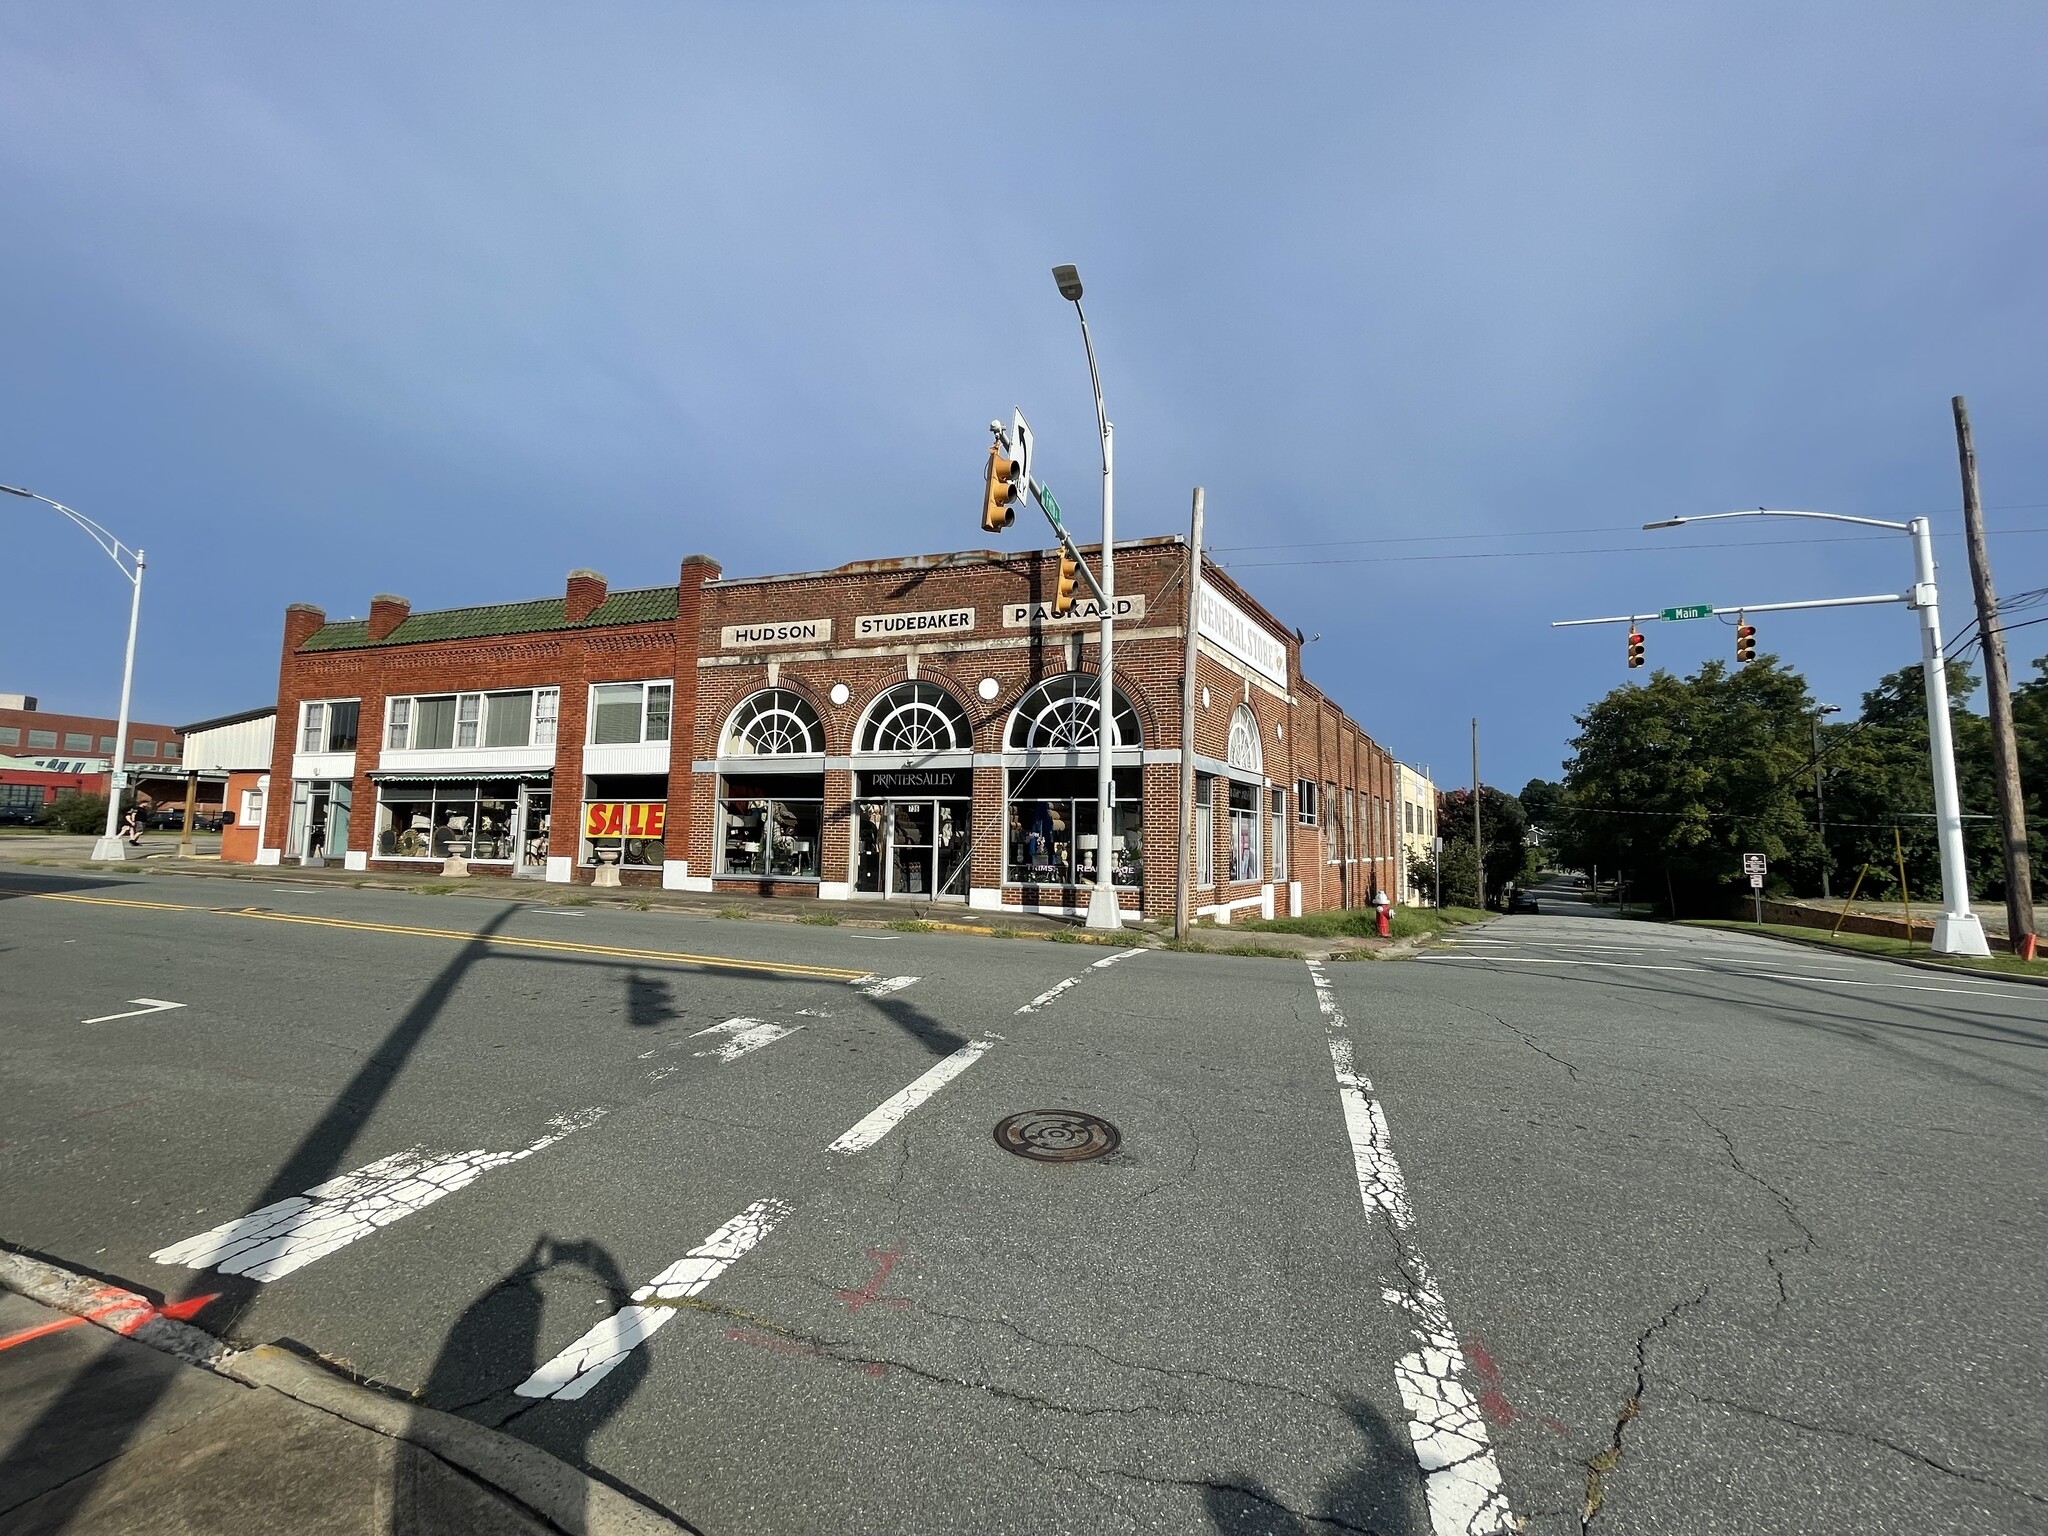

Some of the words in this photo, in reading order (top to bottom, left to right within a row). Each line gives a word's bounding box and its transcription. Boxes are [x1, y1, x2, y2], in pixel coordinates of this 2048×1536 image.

[861, 612, 970, 633] STUDEBAKER
[1675, 607, 1698, 619] Main
[735, 624, 817, 643] HUDSON
[1200, 590, 1247, 654] GENERAL
[1247, 628, 1274, 672] STORE
[588, 802, 664, 836] SALE
